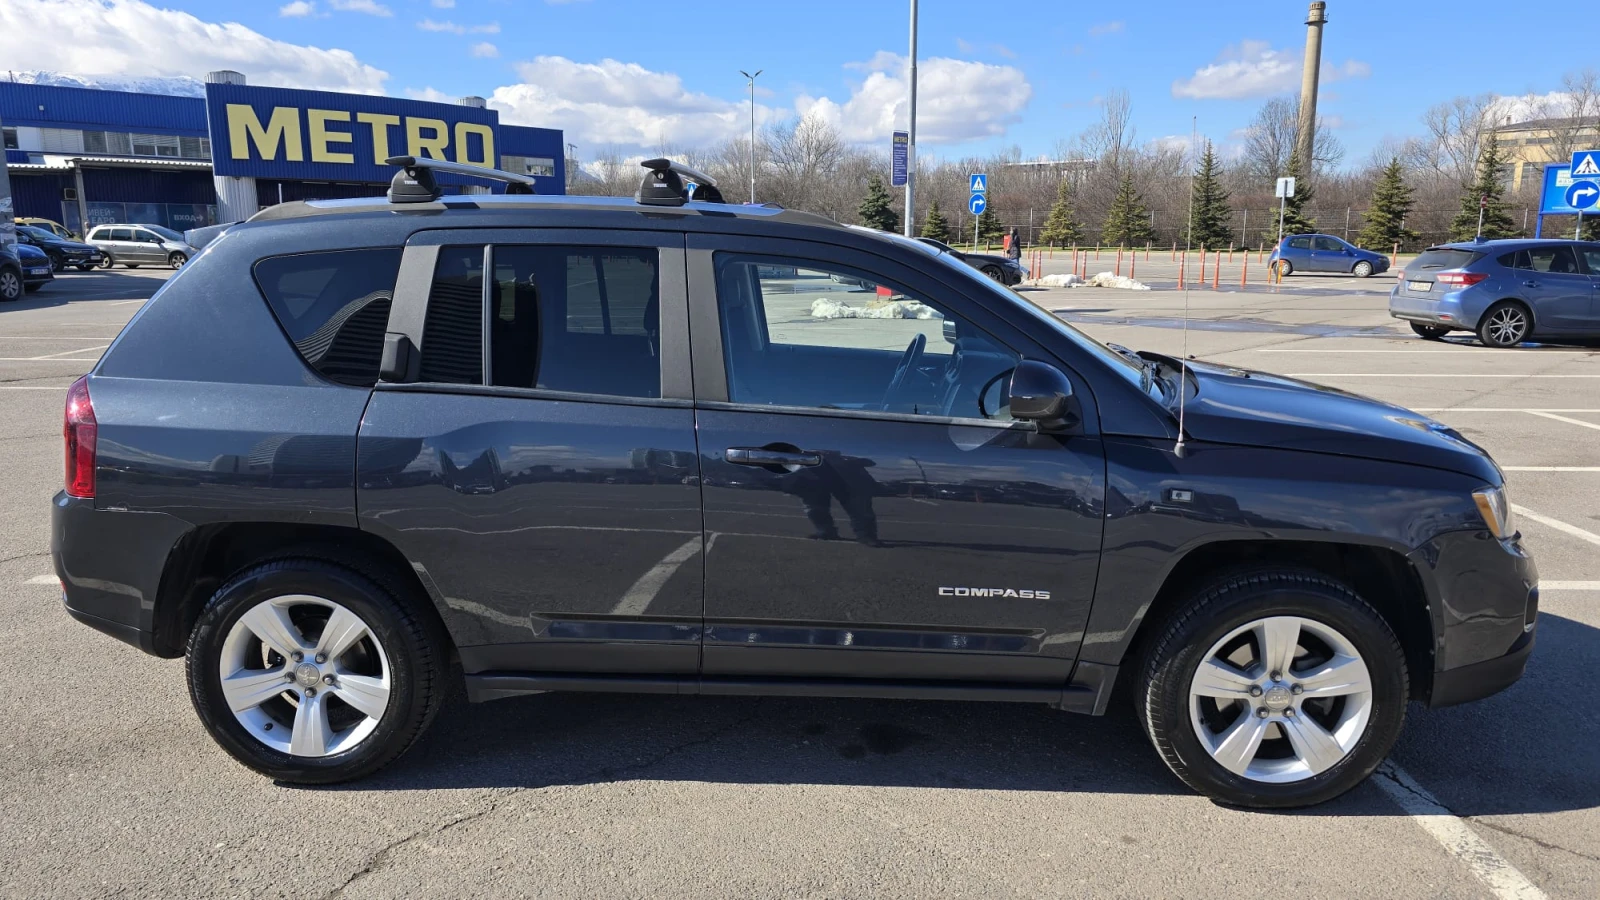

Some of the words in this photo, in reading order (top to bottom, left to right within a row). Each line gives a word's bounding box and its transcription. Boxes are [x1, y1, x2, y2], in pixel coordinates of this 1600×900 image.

[226, 103, 495, 170] METRO
[86, 208, 115, 217] ИВЕЙ-
[174, 214, 196, 222] ВХОД
[938, 587, 1051, 600] COMPASS
